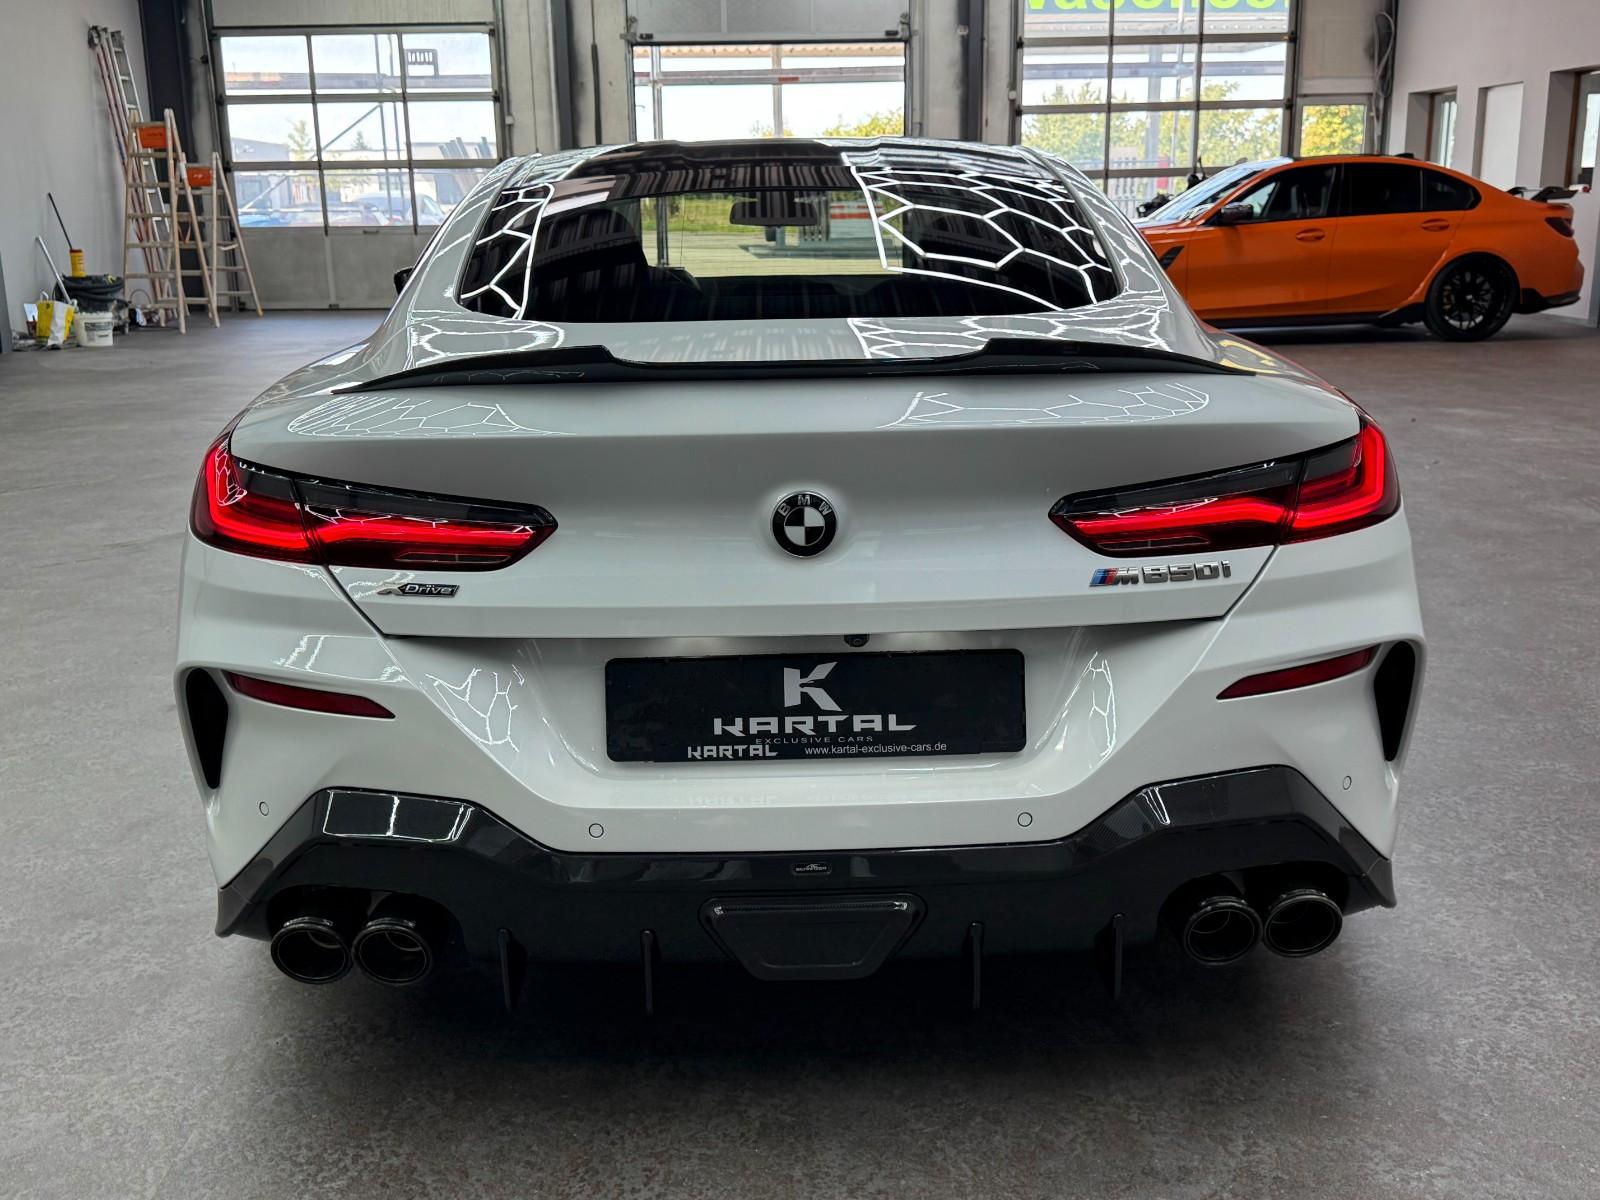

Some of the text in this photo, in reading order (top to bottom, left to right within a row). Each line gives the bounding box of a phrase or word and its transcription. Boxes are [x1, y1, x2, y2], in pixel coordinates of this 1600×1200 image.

[778, 494, 832, 516] BMW
[783, 661, 843, 712] K
[713, 713, 918, 737] KARTAL
[687, 744, 778, 759] KARTAL
[804, 741, 947, 755] www.kartal-exclusive-cars.de
